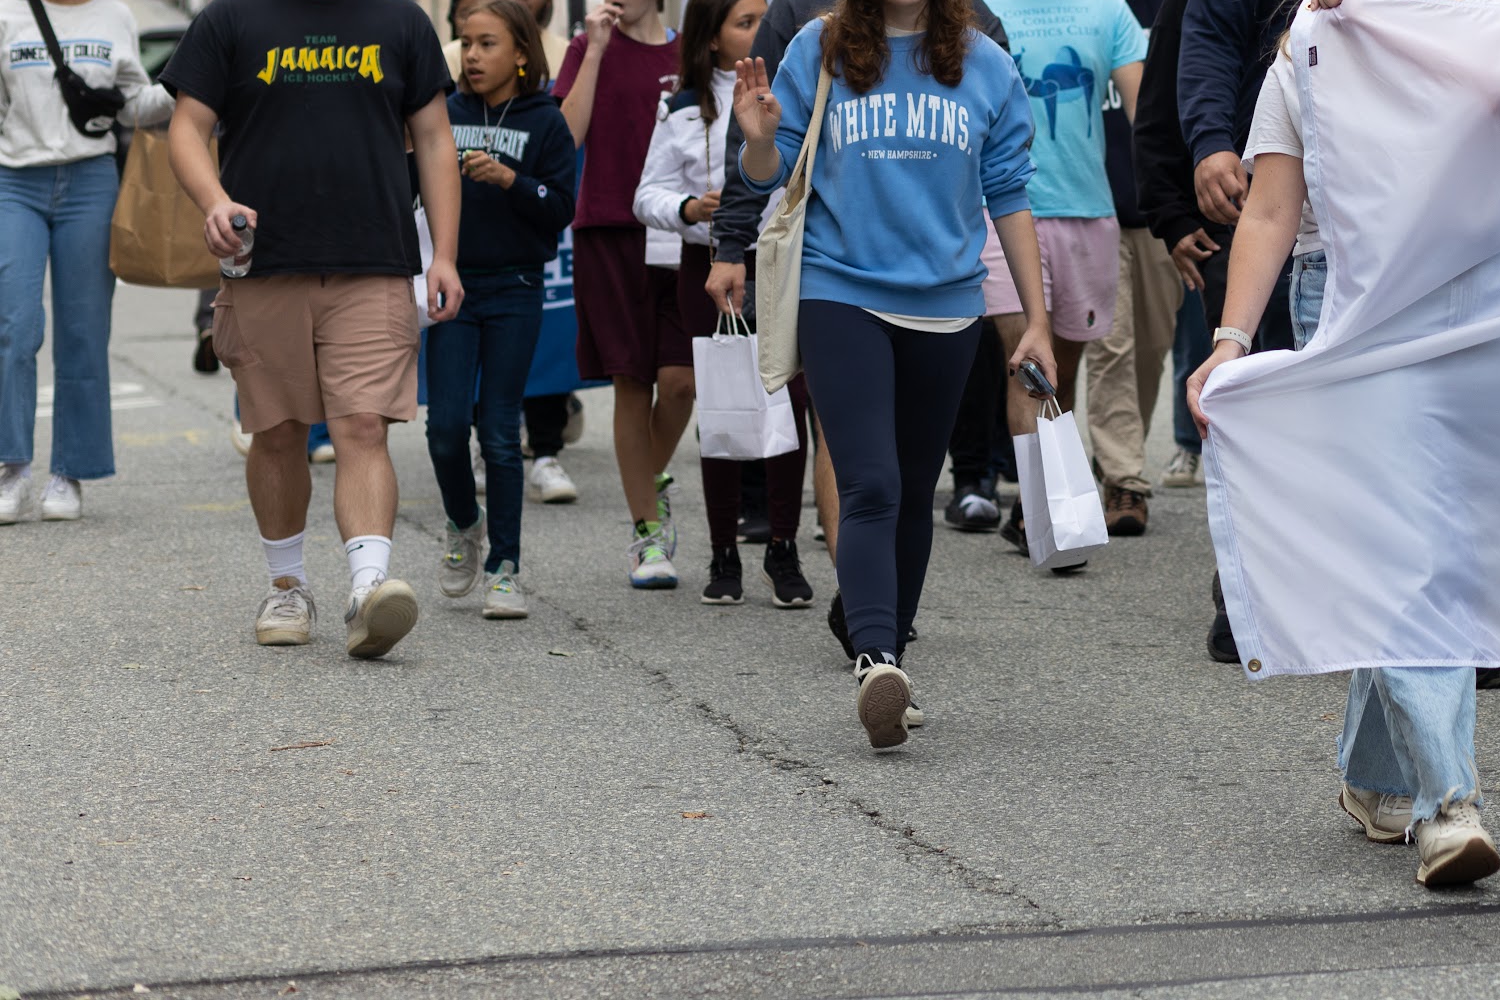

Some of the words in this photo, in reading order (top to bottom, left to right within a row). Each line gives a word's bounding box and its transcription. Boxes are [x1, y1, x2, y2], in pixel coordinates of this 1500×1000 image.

[304, 35, 337, 44] TEAM
[1008, 27, 1063, 41] OBOTICS
[256, 43, 385, 86] JAMAICA
[283, 73, 304, 83] ICE
[306, 72, 357, 84] HOCKEY
[829, 92, 897, 154] WHITE
[451, 124, 531, 162] NNECTICUT
[867, 150, 886, 160] NEW
[887, 150, 932, 160] HAMPSHIRE
